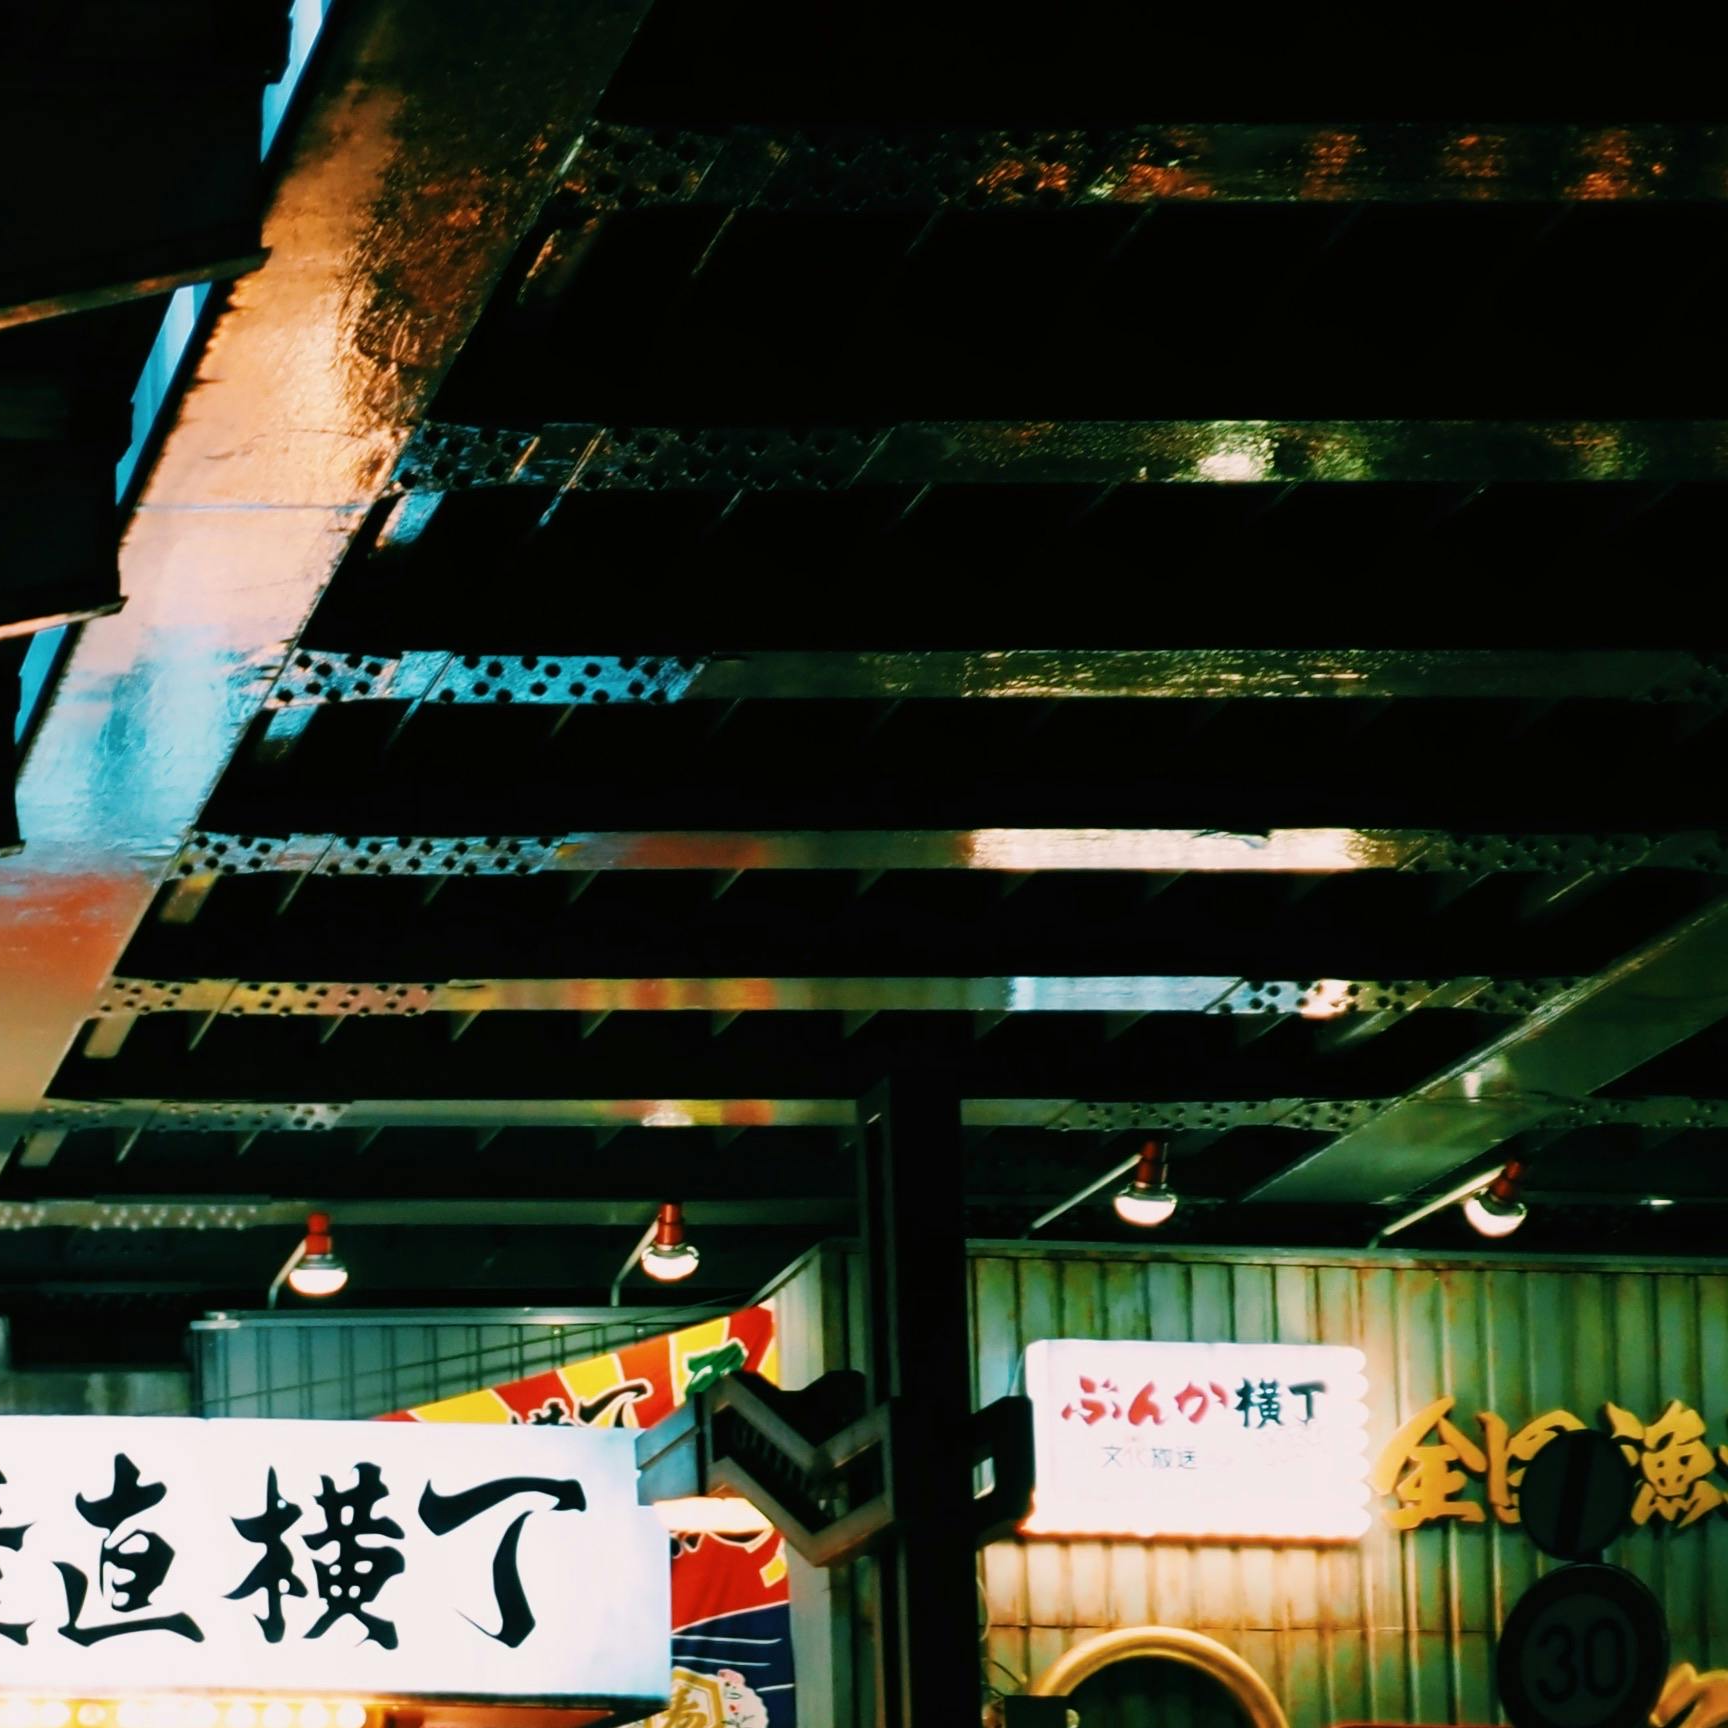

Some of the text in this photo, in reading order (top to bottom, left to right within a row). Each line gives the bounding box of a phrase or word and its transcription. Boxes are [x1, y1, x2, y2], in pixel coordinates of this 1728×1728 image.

[1061, 1375, 1329, 1428] ぶんか横丁
[1534, 1616, 1629, 1703] 30
